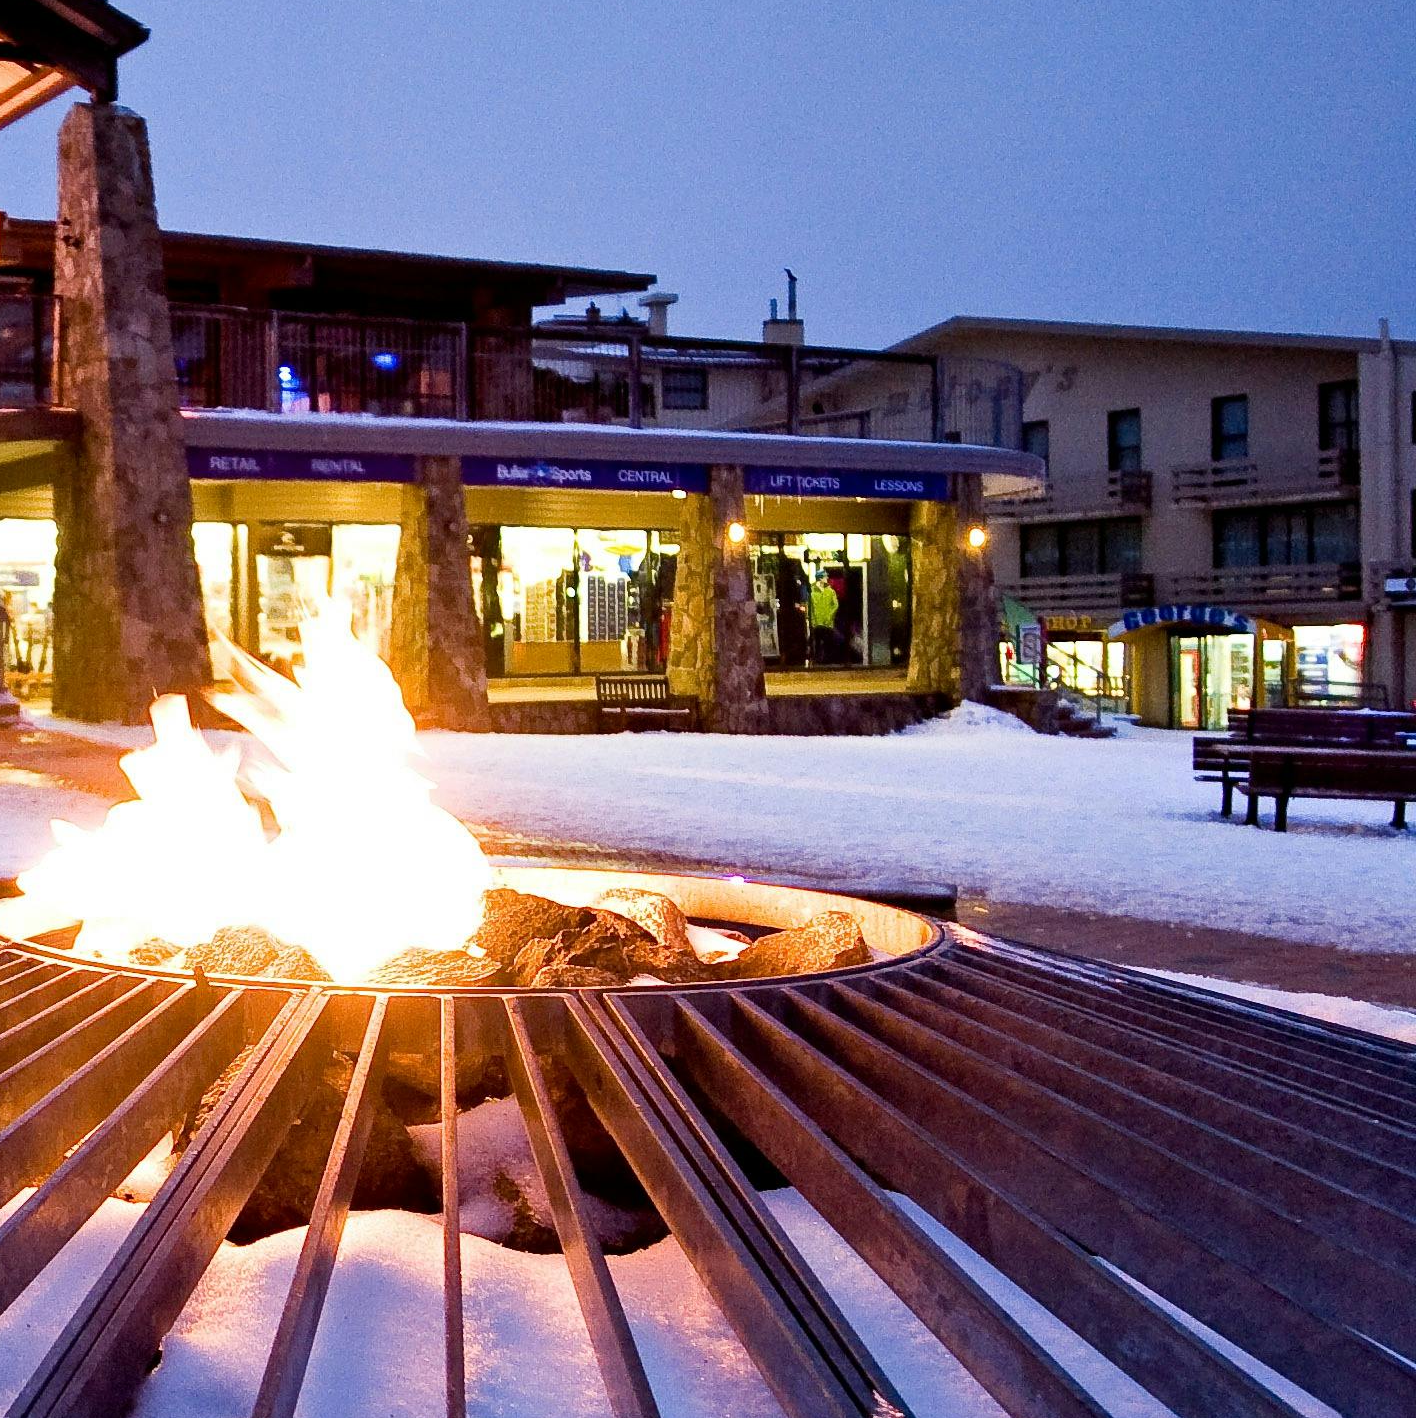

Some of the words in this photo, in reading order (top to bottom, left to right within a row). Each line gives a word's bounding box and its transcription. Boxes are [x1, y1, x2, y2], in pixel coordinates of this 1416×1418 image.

[209, 456, 261, 472] RETAIL
[311, 458, 366, 474] RENTAL
[551, 466, 592, 484] Sports
[618, 469, 674, 484] CENTRAL
[770, 474, 793, 487] LIFT
[796, 476, 840, 489] TICKETS
[874, 479, 924, 492] LESSONS
